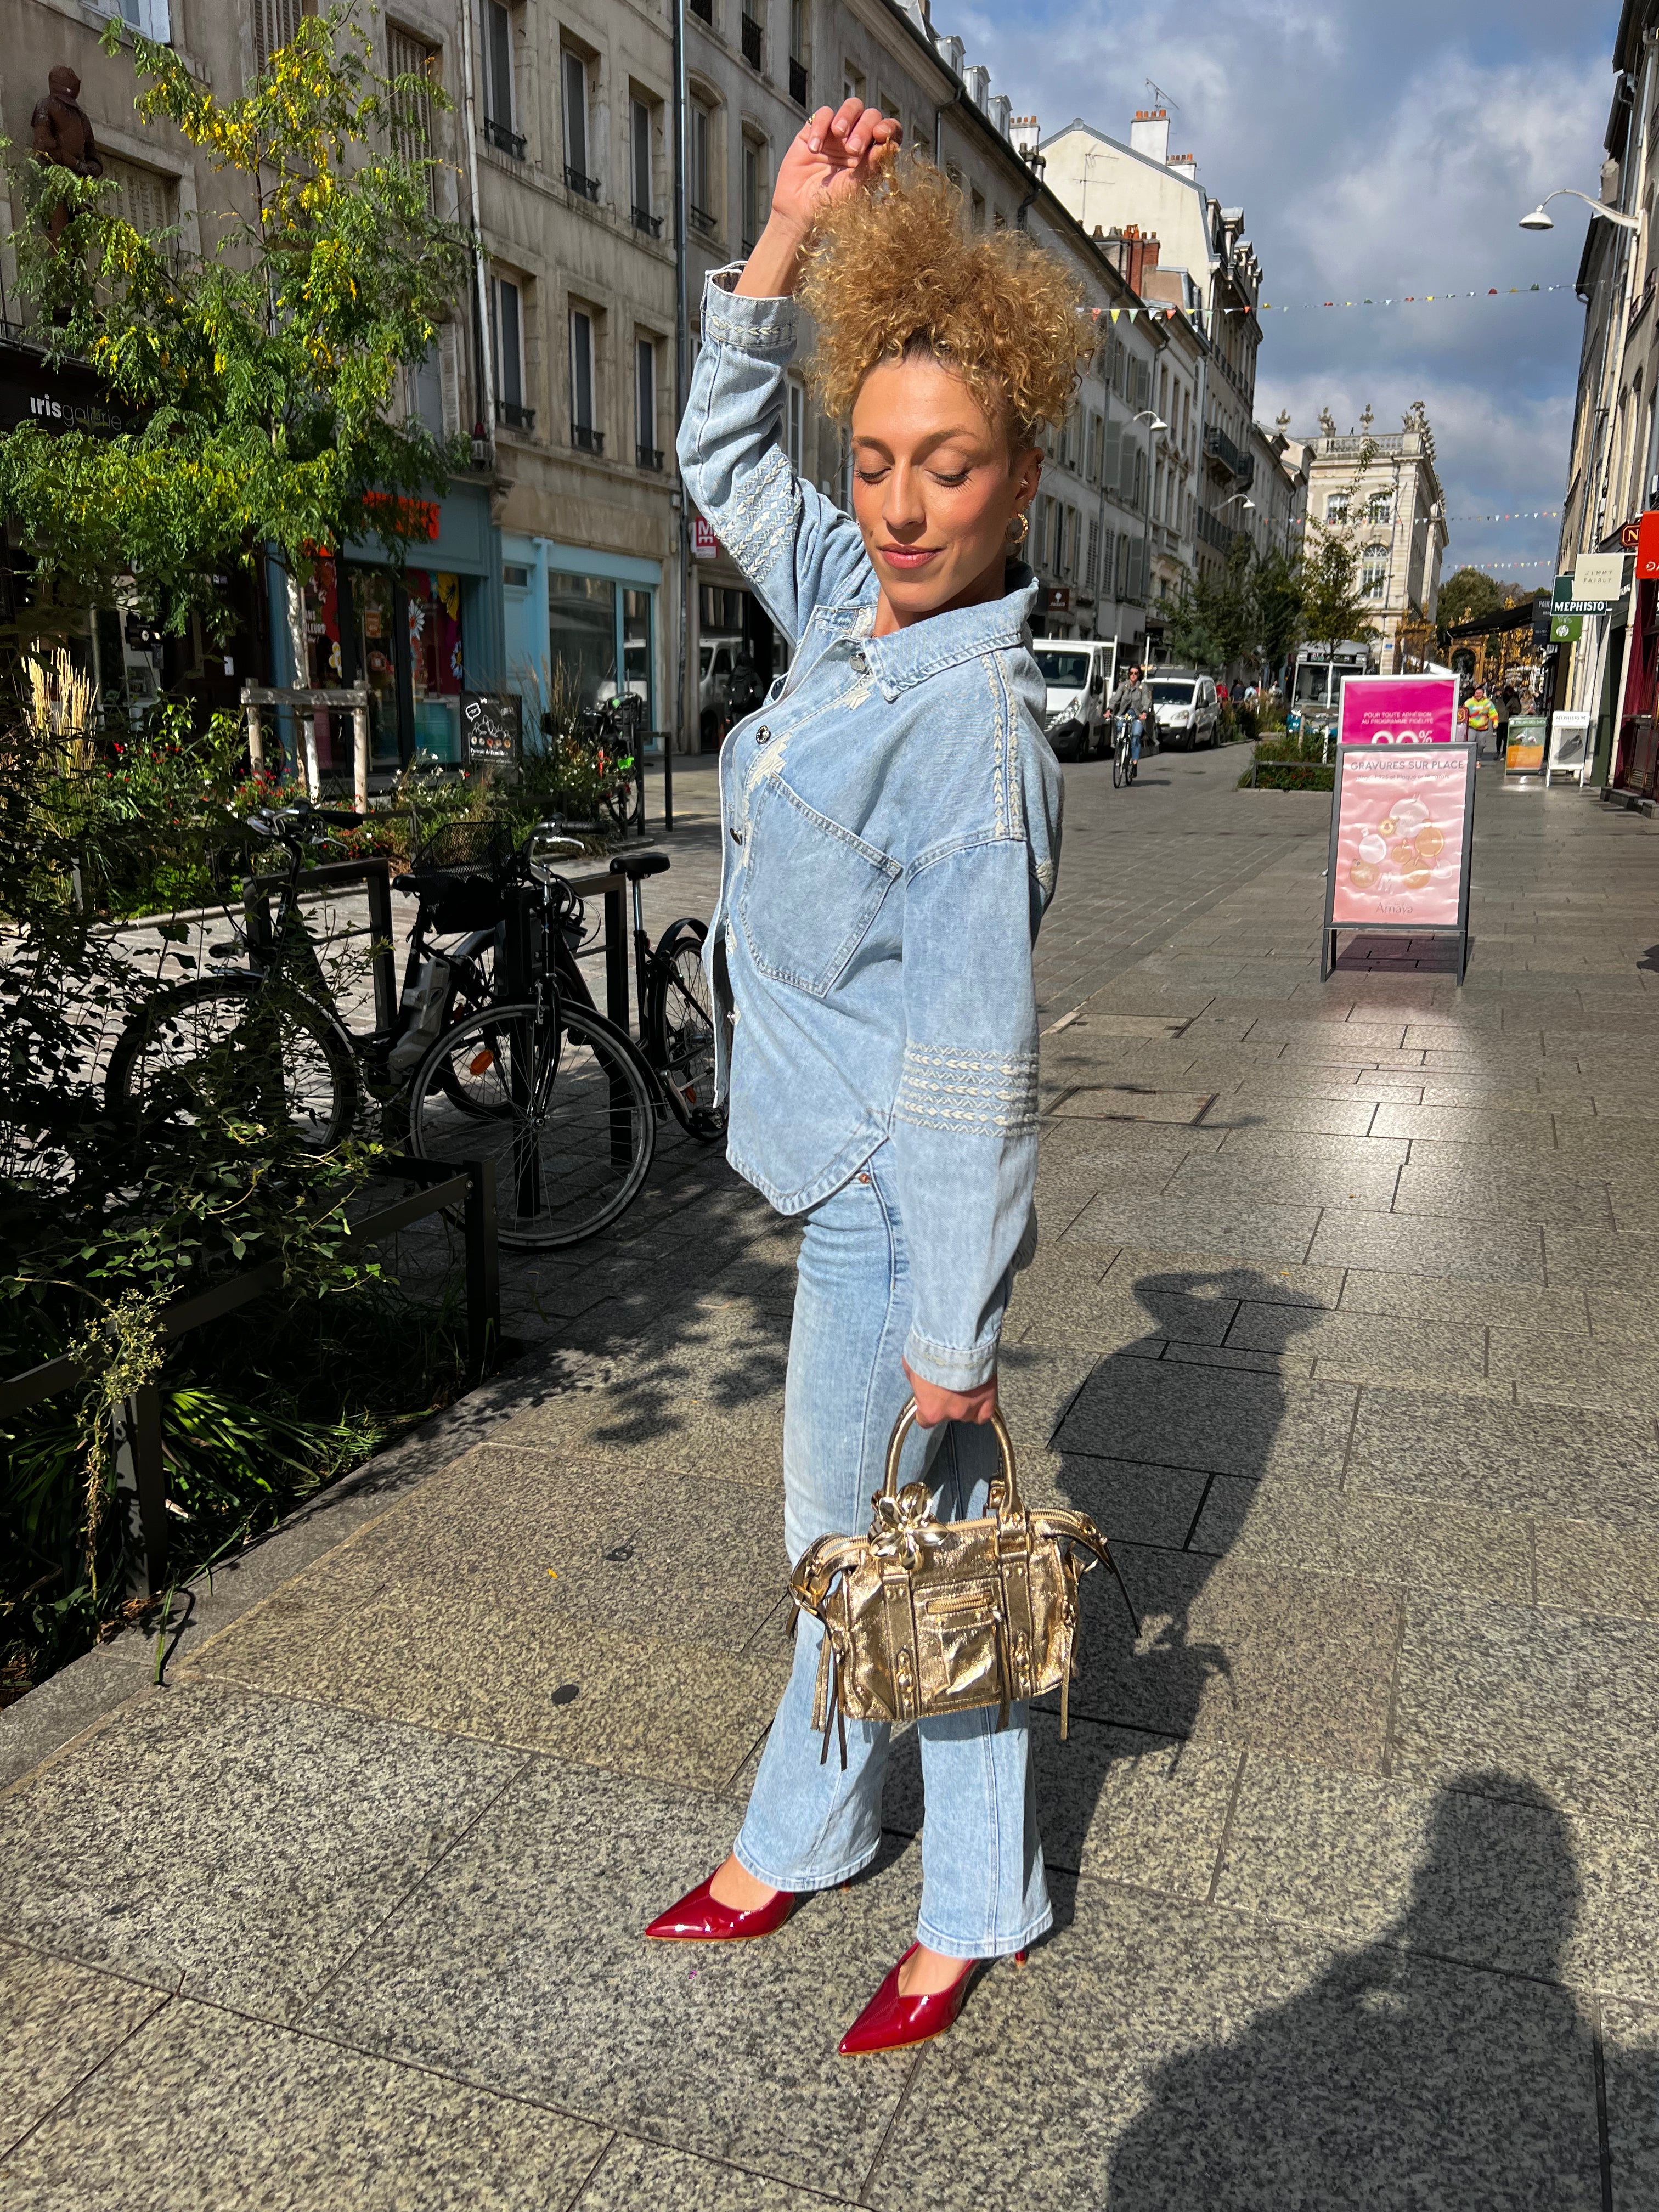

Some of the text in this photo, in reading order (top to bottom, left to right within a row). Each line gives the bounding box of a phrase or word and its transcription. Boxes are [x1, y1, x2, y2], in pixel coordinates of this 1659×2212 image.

[1554, 601, 1605, 612] MEPHISTO
[1351, 760, 1464, 770] GRAVURES SUR PLACE
[1376, 902, 1413, 914] Amaya
